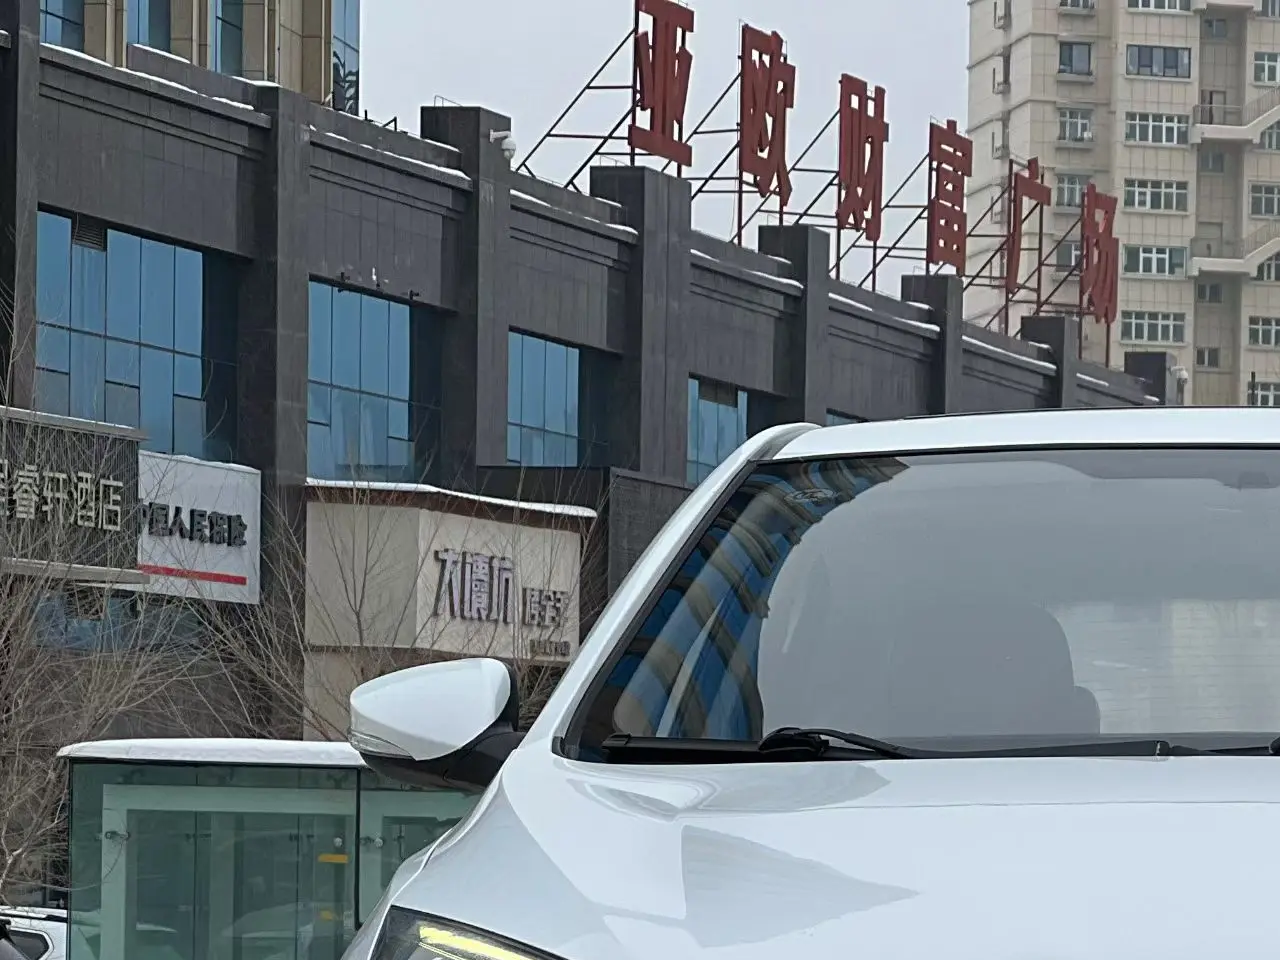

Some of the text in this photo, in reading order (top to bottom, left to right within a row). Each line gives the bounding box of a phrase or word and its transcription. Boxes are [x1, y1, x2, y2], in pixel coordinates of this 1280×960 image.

[628, 0, 1120, 325] 亚欧财富广场
